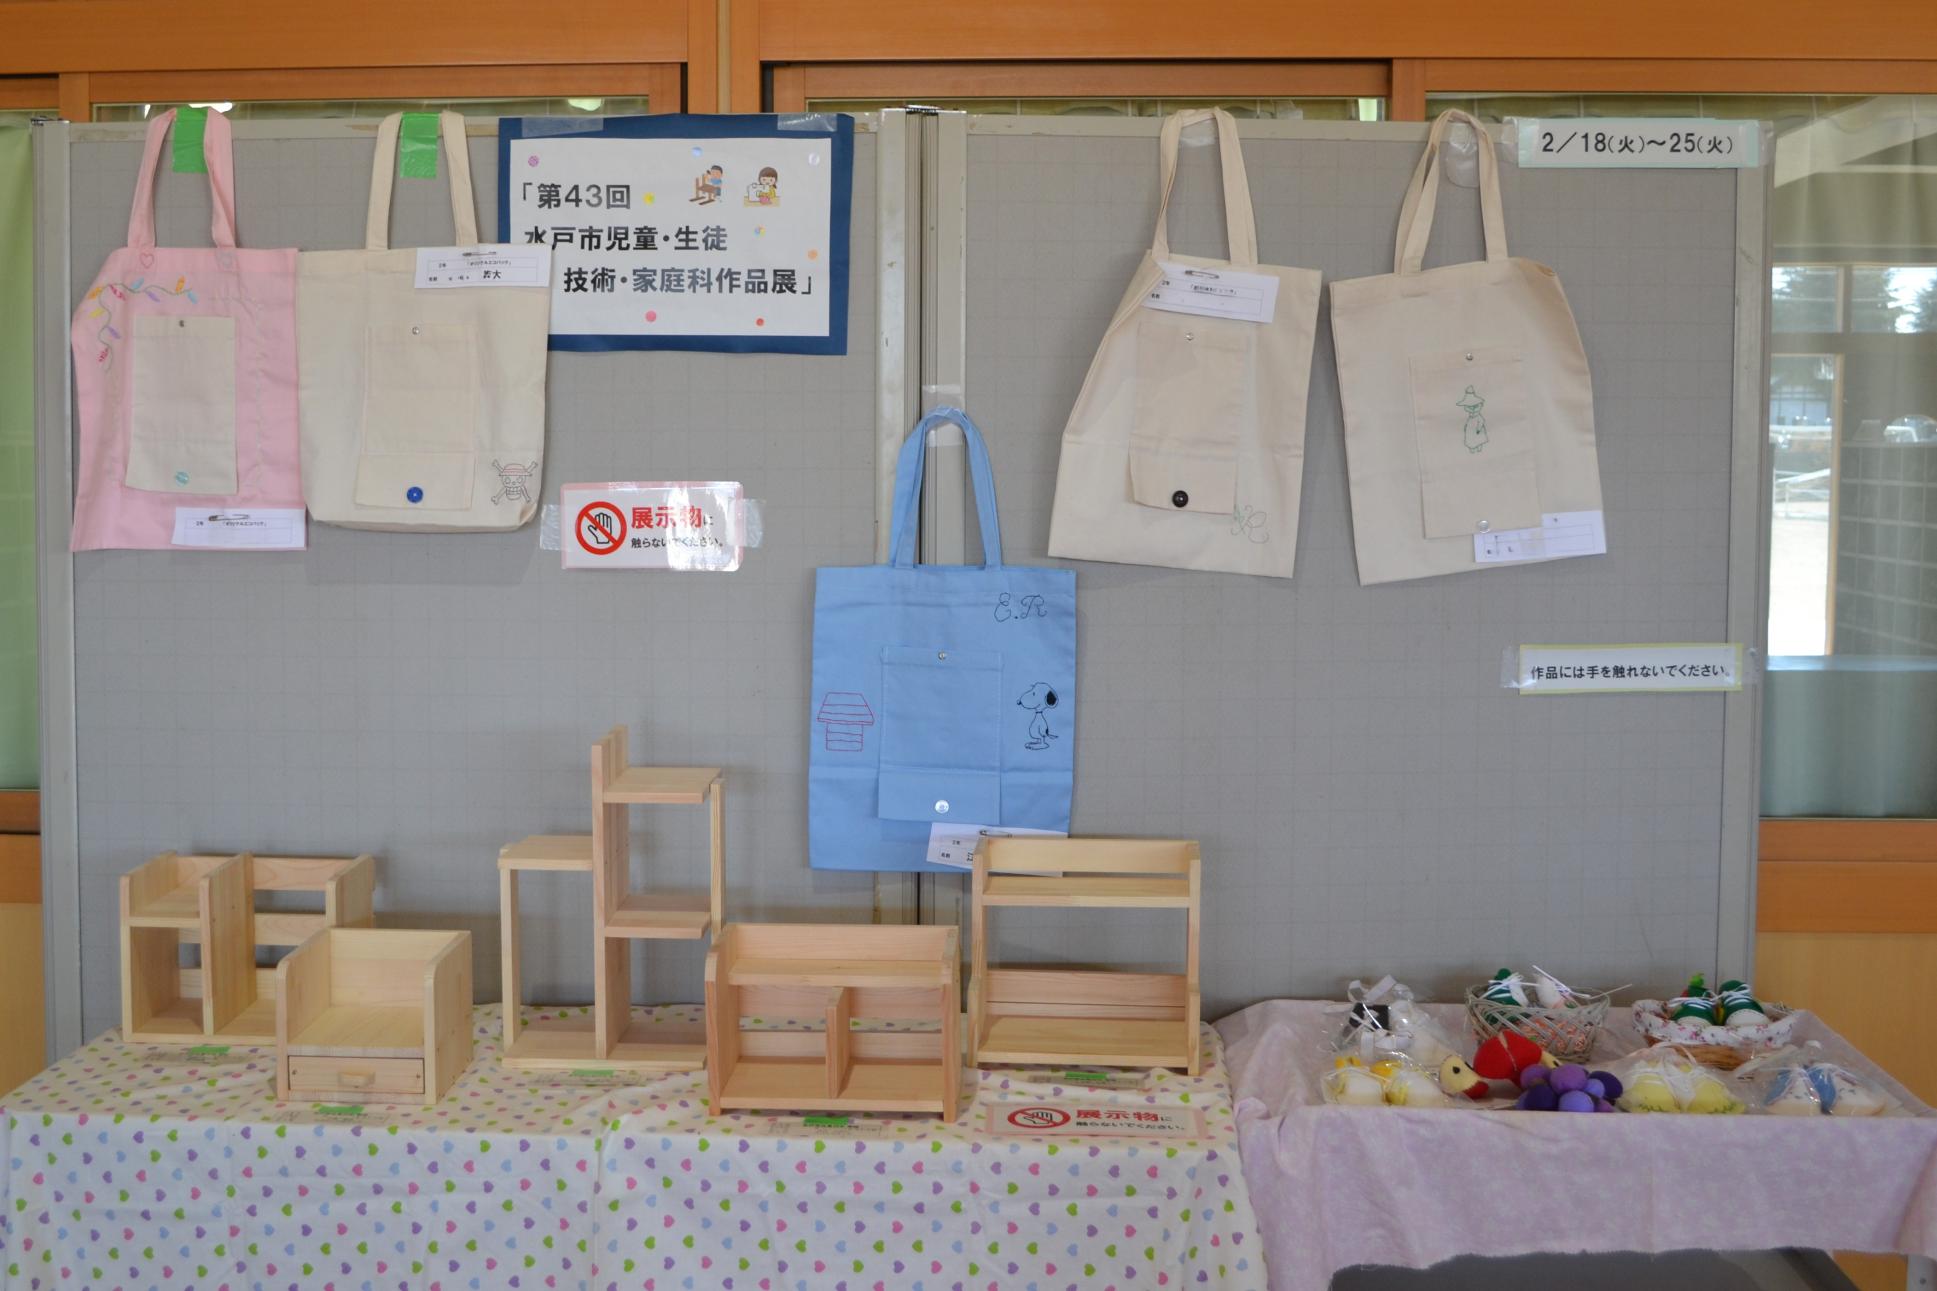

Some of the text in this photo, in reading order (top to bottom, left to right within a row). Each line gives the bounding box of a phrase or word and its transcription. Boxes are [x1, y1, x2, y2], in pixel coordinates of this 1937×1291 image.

[521, 182, 632, 210] 「第43回
[525, 225, 728, 252] 水戸市児童・生徒
[563, 266, 813, 296] 技術・家庭科作品展」
[631, 506, 714, 529] 展示物に
[1530, 664, 1732, 680] 作品には手を触れないでください。
[1076, 1109, 1174, 1122] 展示物に
